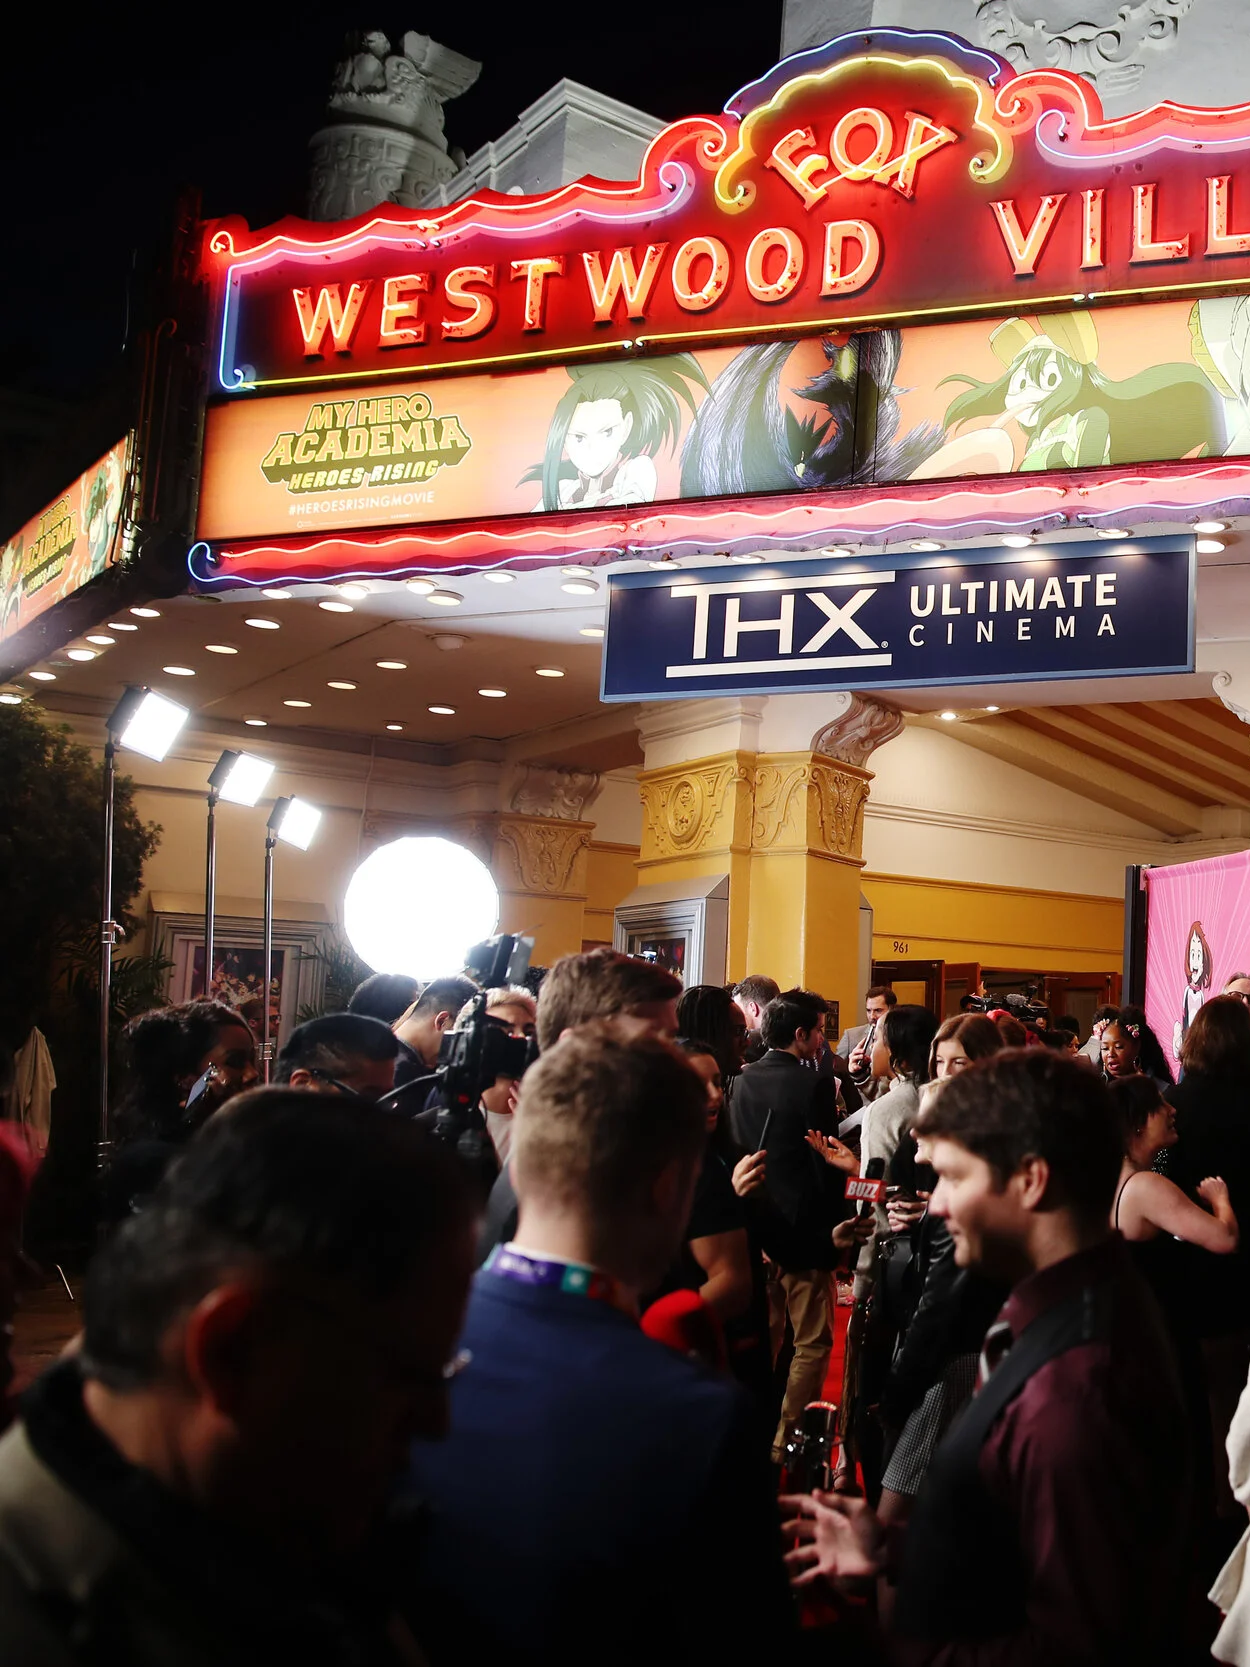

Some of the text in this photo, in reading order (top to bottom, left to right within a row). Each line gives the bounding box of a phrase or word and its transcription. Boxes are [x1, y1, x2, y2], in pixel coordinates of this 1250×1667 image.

[764, 107, 958, 211] FOX
[291, 217, 881, 358] WESTWOOD
[306, 394, 431, 431] MY HERO
[262, 417, 471, 468] ACADEMIA
[288, 460, 439, 490] HEROES RISING
[288, 491, 435, 516] #HEROESRISINGMOVIE
[669, 570, 1118, 662] THX ULTIMATE
[908, 612, 1117, 648] CINEMA
[893, 941, 909, 953] 961
[847, 1181, 879, 1199] BUZZ
